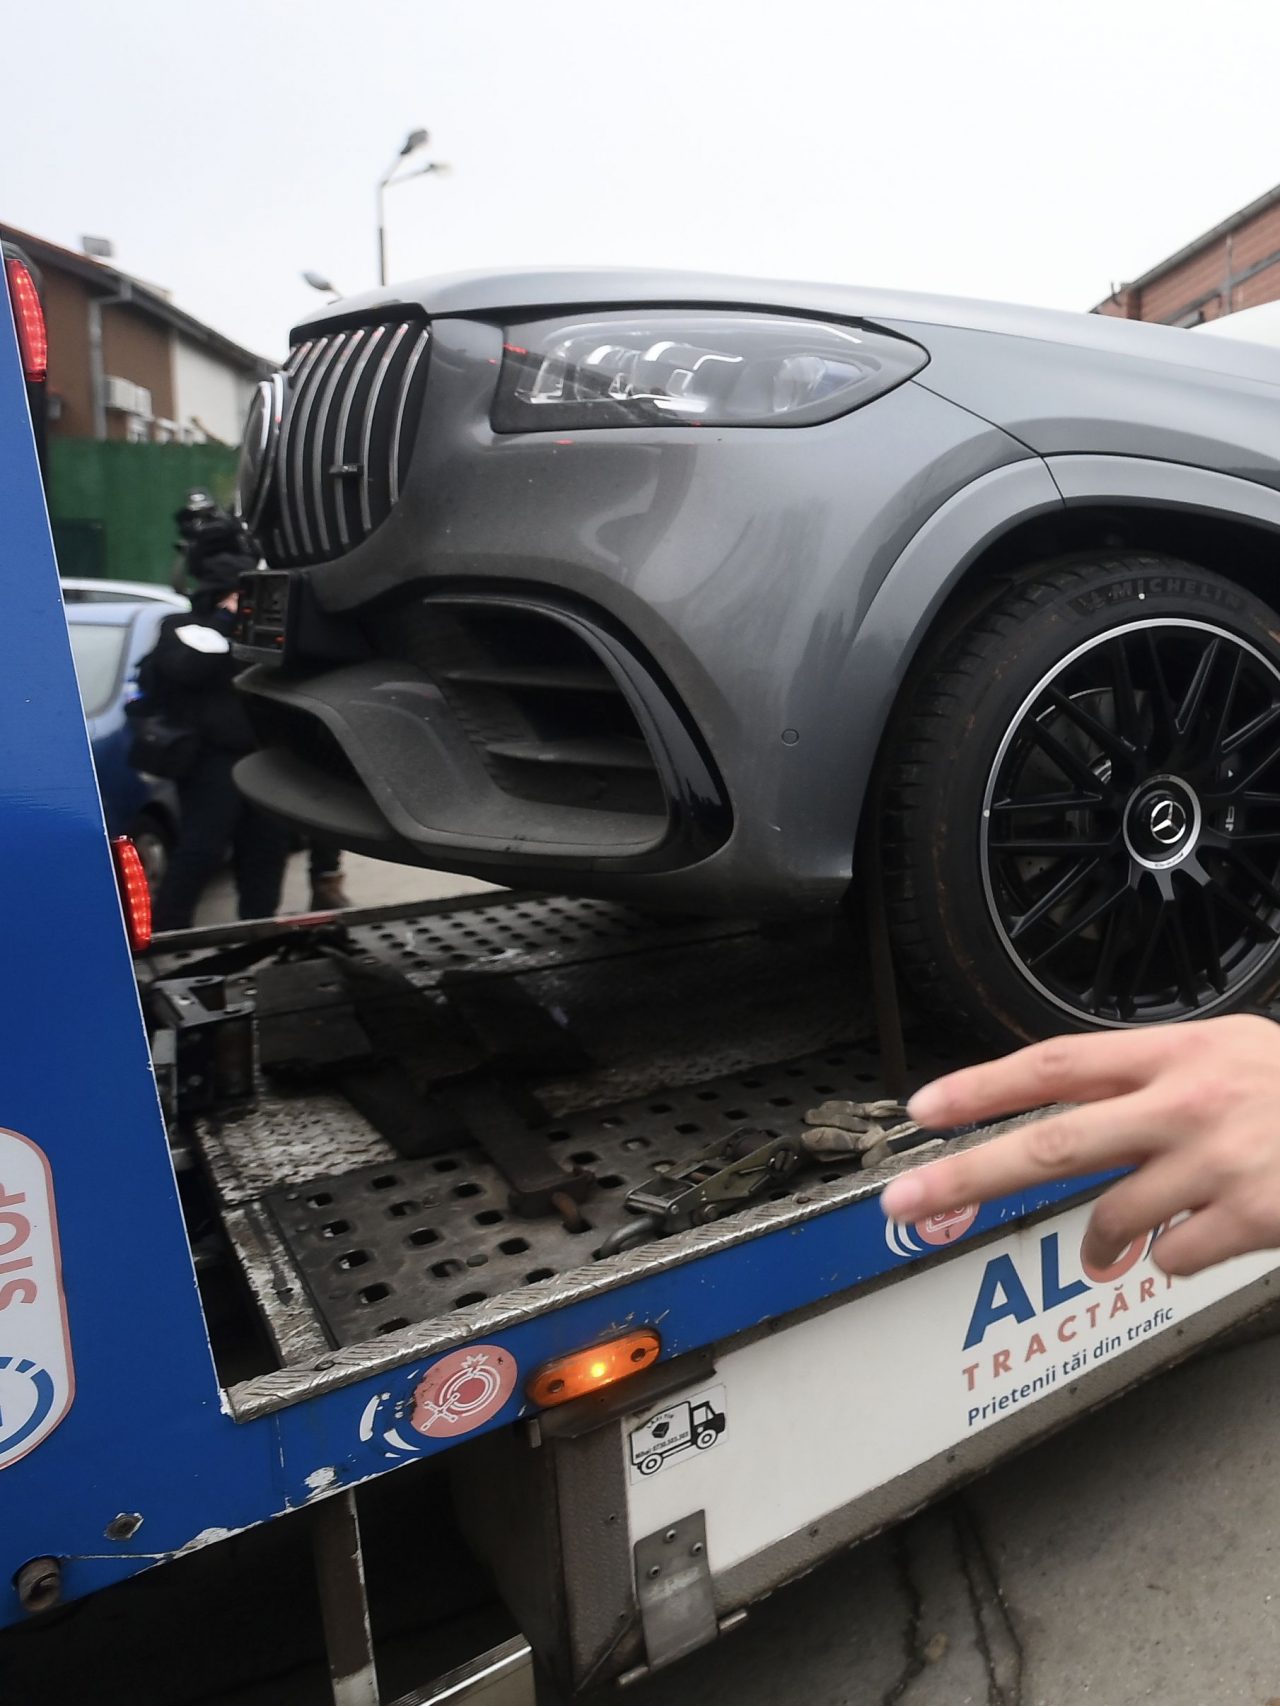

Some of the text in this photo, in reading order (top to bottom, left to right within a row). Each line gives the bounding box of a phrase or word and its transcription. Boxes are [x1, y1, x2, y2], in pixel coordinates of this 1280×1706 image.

[1112, 578, 1240, 608] MICHELIN
[0, 1182, 38, 1311] SO
[968, 1306, 1174, 1427] Prietenii tăi din trafic
